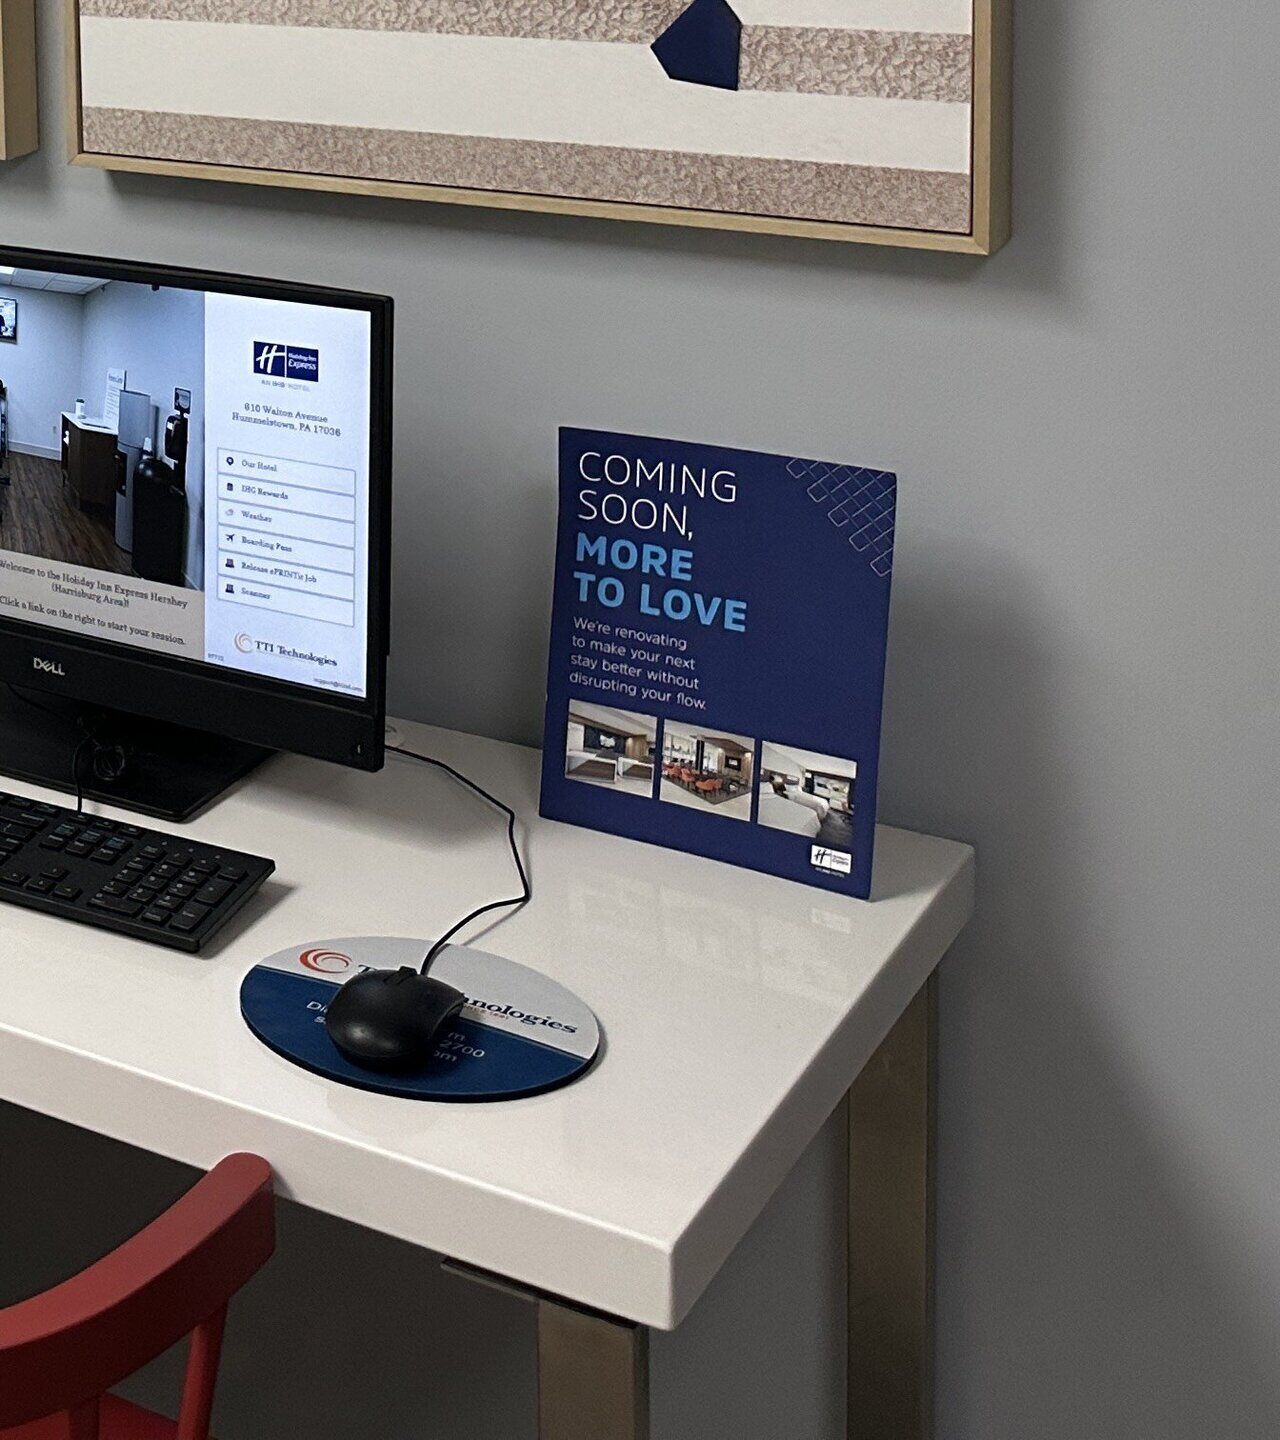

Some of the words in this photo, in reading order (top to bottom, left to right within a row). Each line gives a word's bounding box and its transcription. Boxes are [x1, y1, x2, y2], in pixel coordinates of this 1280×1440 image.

[299, 422, 310, 432] PA
[579, 449, 737, 503] COMING
[578, 488, 693, 541] SOON,
[575, 530, 694, 582] MORE
[37, 567, 45, 576] to
[47, 569, 60, 579] the
[62, 572, 94, 589] Holiday
[97, 580, 112, 591] Inn
[114, 584, 147, 599] Express
[150, 592, 187, 610] Hershey
[572, 570, 625, 610] TO
[640, 582, 747, 633] LOVE
[0, 595, 19, 608] Click
[21, 602, 26, 610] a
[28, 601, 44, 614] link
[47, 608, 57, 617] on
[59, 609, 72, 620] the
[74, 613, 95, 625] right
[97, 618, 105, 628] to
[107, 622, 126, 633] start
[129, 627, 148, 638] your
[573, 615, 610, 636] We're
[615, 627, 686, 653] renovating
[33, 658, 65, 676] DELL
[277, 644, 337, 667] Technologies
[570, 653, 597, 671] stay
[602, 657, 641, 679] better
[646, 669, 699, 691] without
[572, 634, 585, 648] to
[589, 641, 626, 657] make
[629, 647, 660, 663] your
[664, 656, 695, 671] next
[569, 669, 636, 698] disrupting
[640, 686, 671, 702] your
[676, 691, 706, 711] flow.
